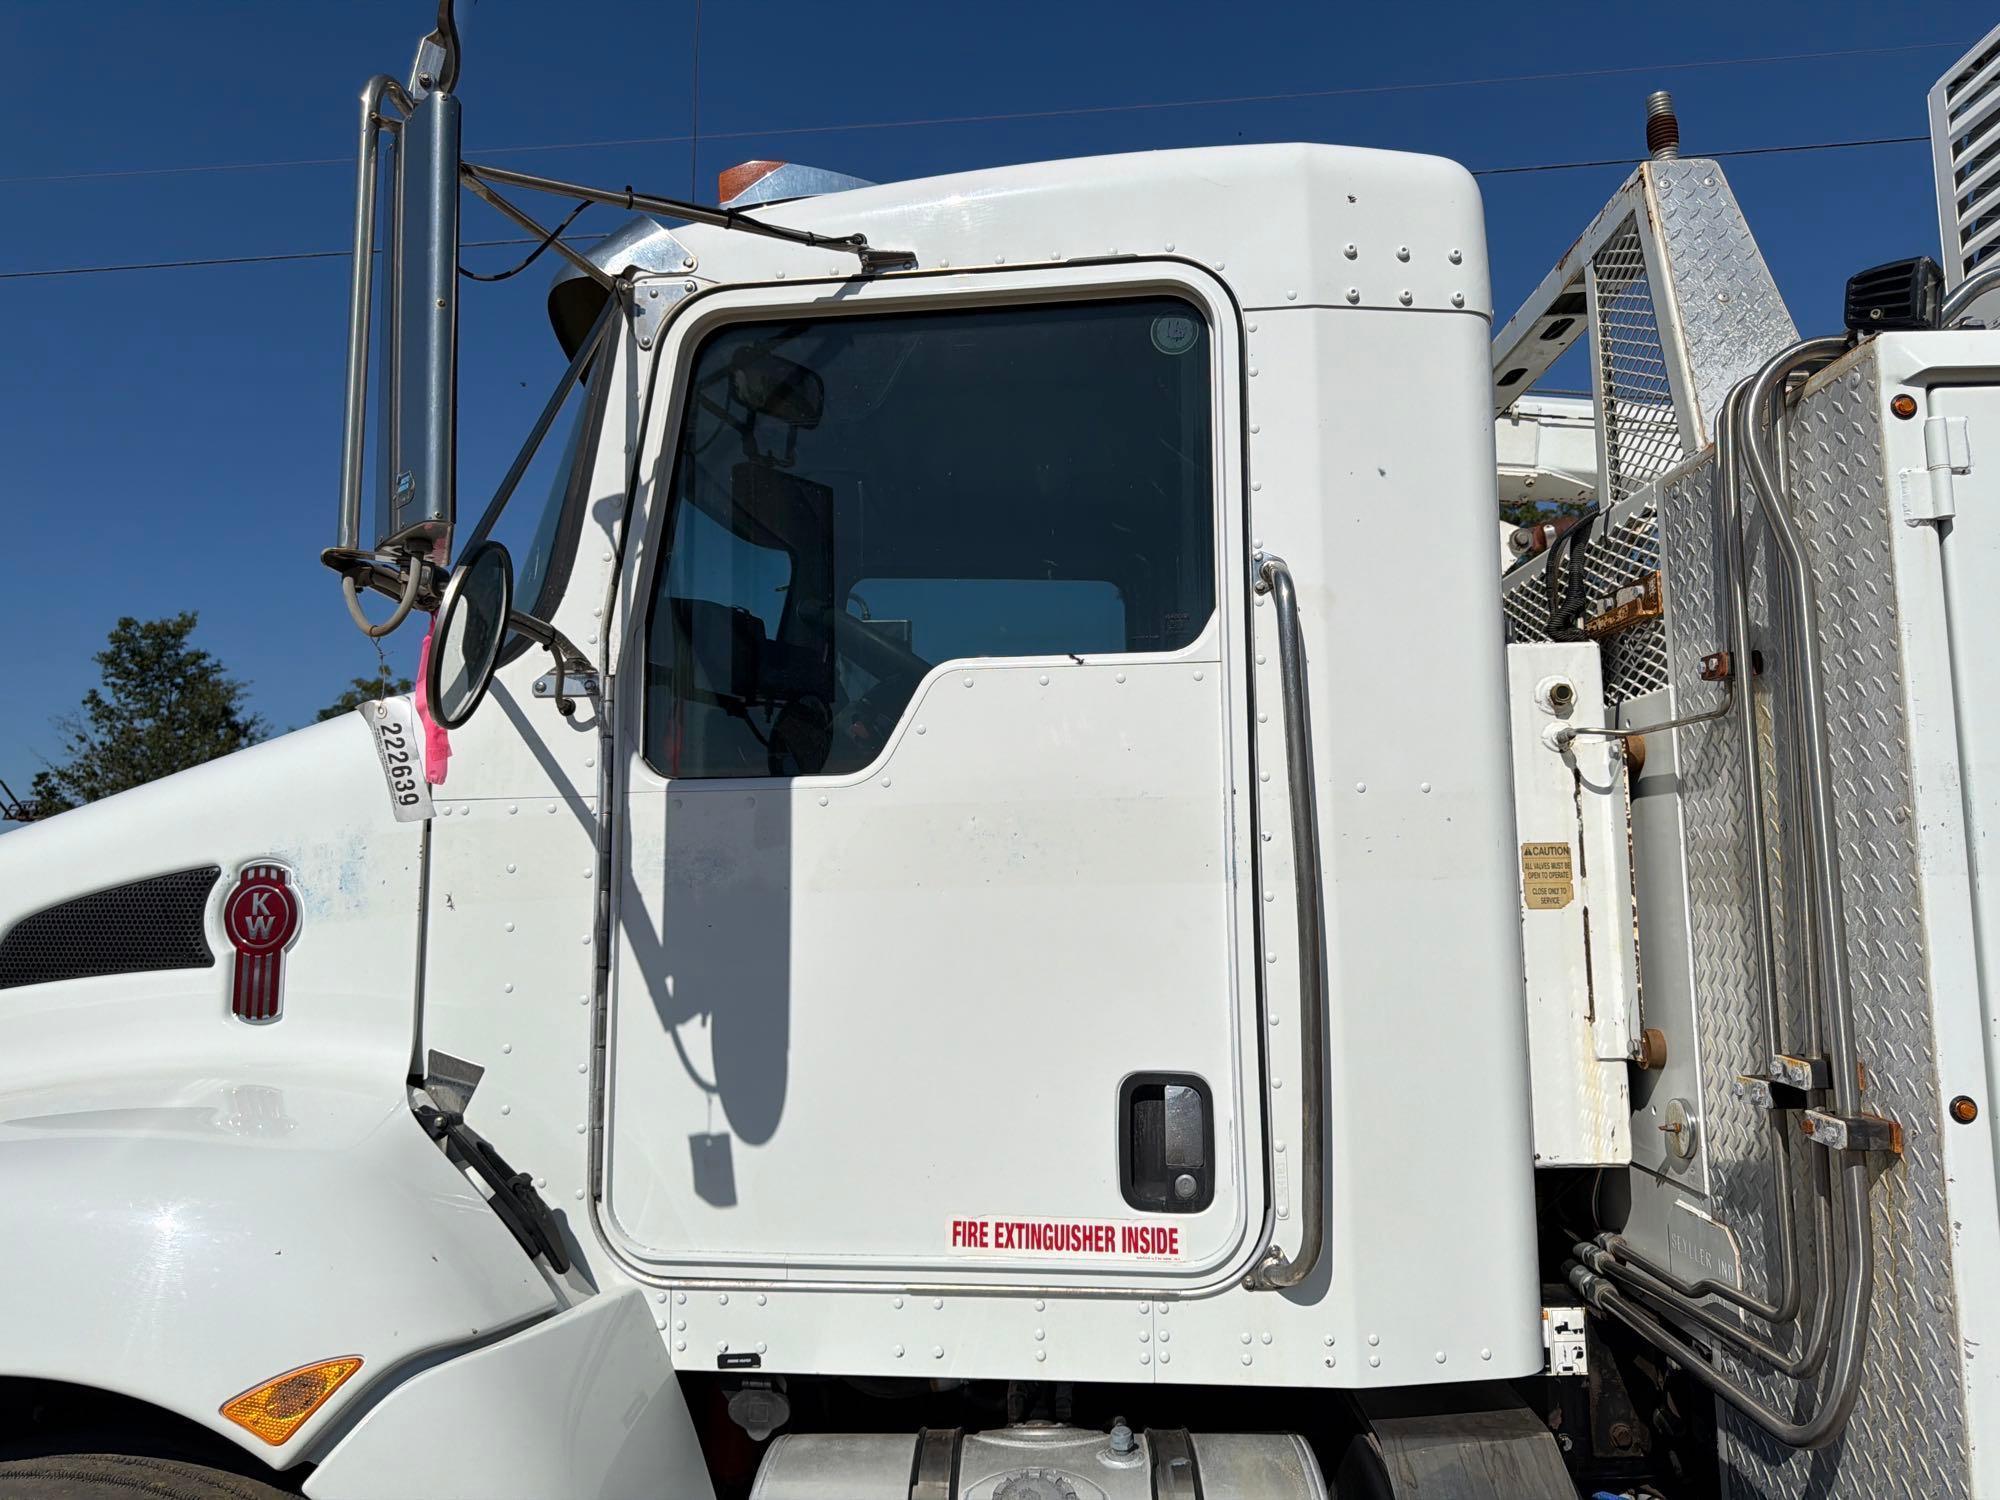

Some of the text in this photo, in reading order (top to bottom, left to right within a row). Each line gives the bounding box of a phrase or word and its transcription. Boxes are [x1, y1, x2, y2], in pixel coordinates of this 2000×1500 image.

[380, 722, 420, 806] 222639
[1532, 846, 1569, 856] CAUTION
[1525, 862, 1571, 870] ALL VALVES MUST BE
[1528, 871, 1569, 879] OPEN TO OPERATE
[1532, 888, 1547, 896] CLOSE
[252, 892, 272, 916] K
[1540, 897, 1561, 905] SERVICE
[244, 915, 277, 940] W
[952, 1220, 1179, 1255] FIRE EXTINGUISHER INSIDE
[1671, 1233, 1735, 1282] SEYLLER IND
